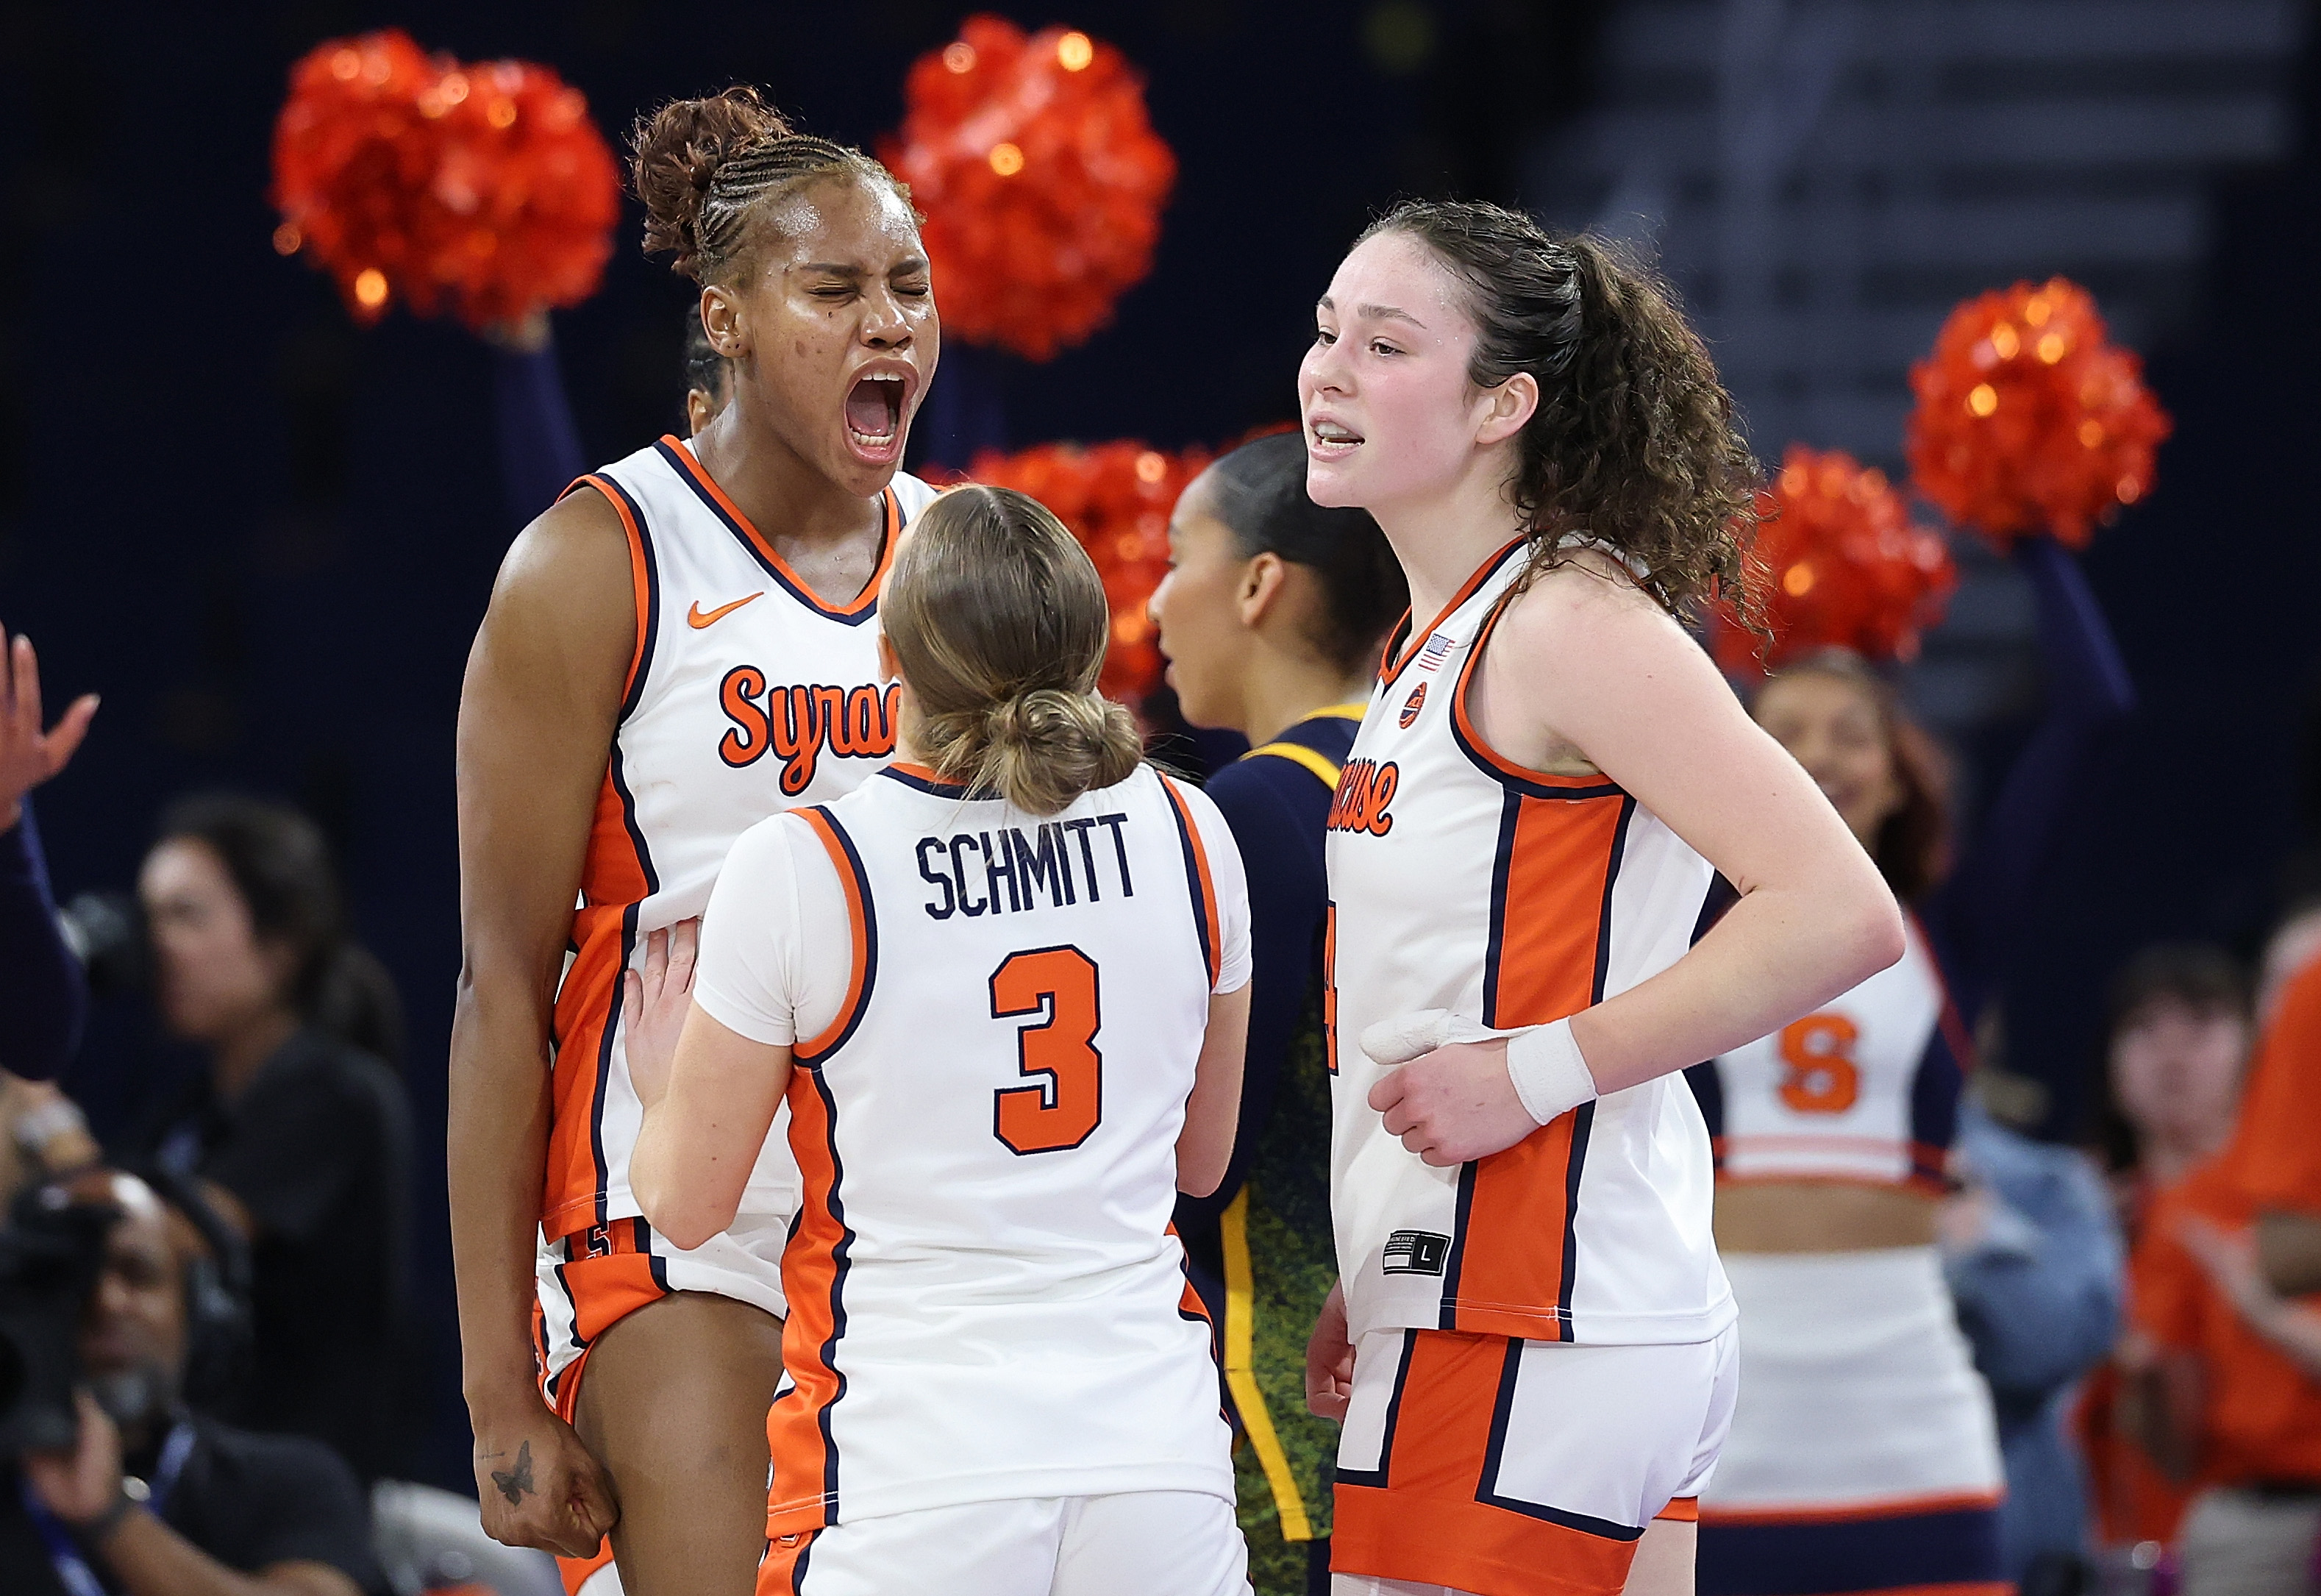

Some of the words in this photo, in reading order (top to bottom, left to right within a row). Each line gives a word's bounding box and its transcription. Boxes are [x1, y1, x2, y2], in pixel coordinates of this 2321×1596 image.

[916, 813, 1133, 919] SCHMITT
[988, 944, 1102, 1155] 3
[1421, 1244, 1430, 1261] L
